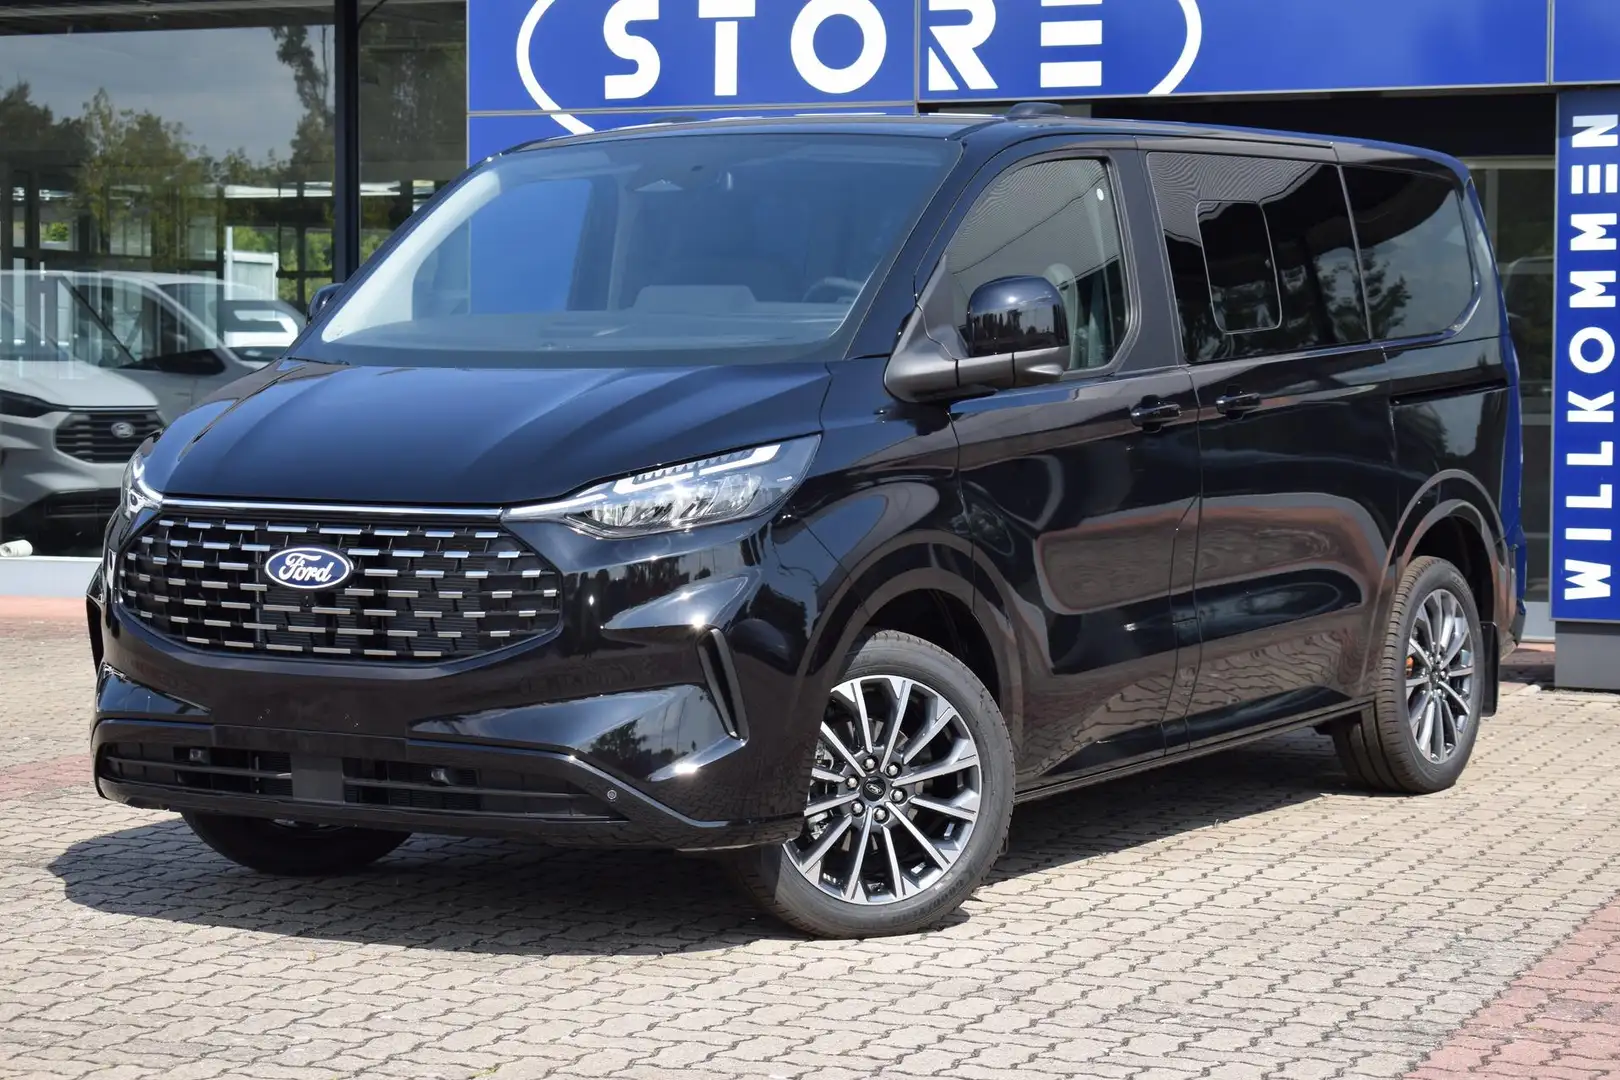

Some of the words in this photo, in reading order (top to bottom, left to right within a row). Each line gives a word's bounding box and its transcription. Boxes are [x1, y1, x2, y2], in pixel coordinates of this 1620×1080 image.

[604, 0, 1102, 99] STORE
[1565, 115, 1618, 600] WILLKOMMEN
[279, 552, 335, 582] Ford
